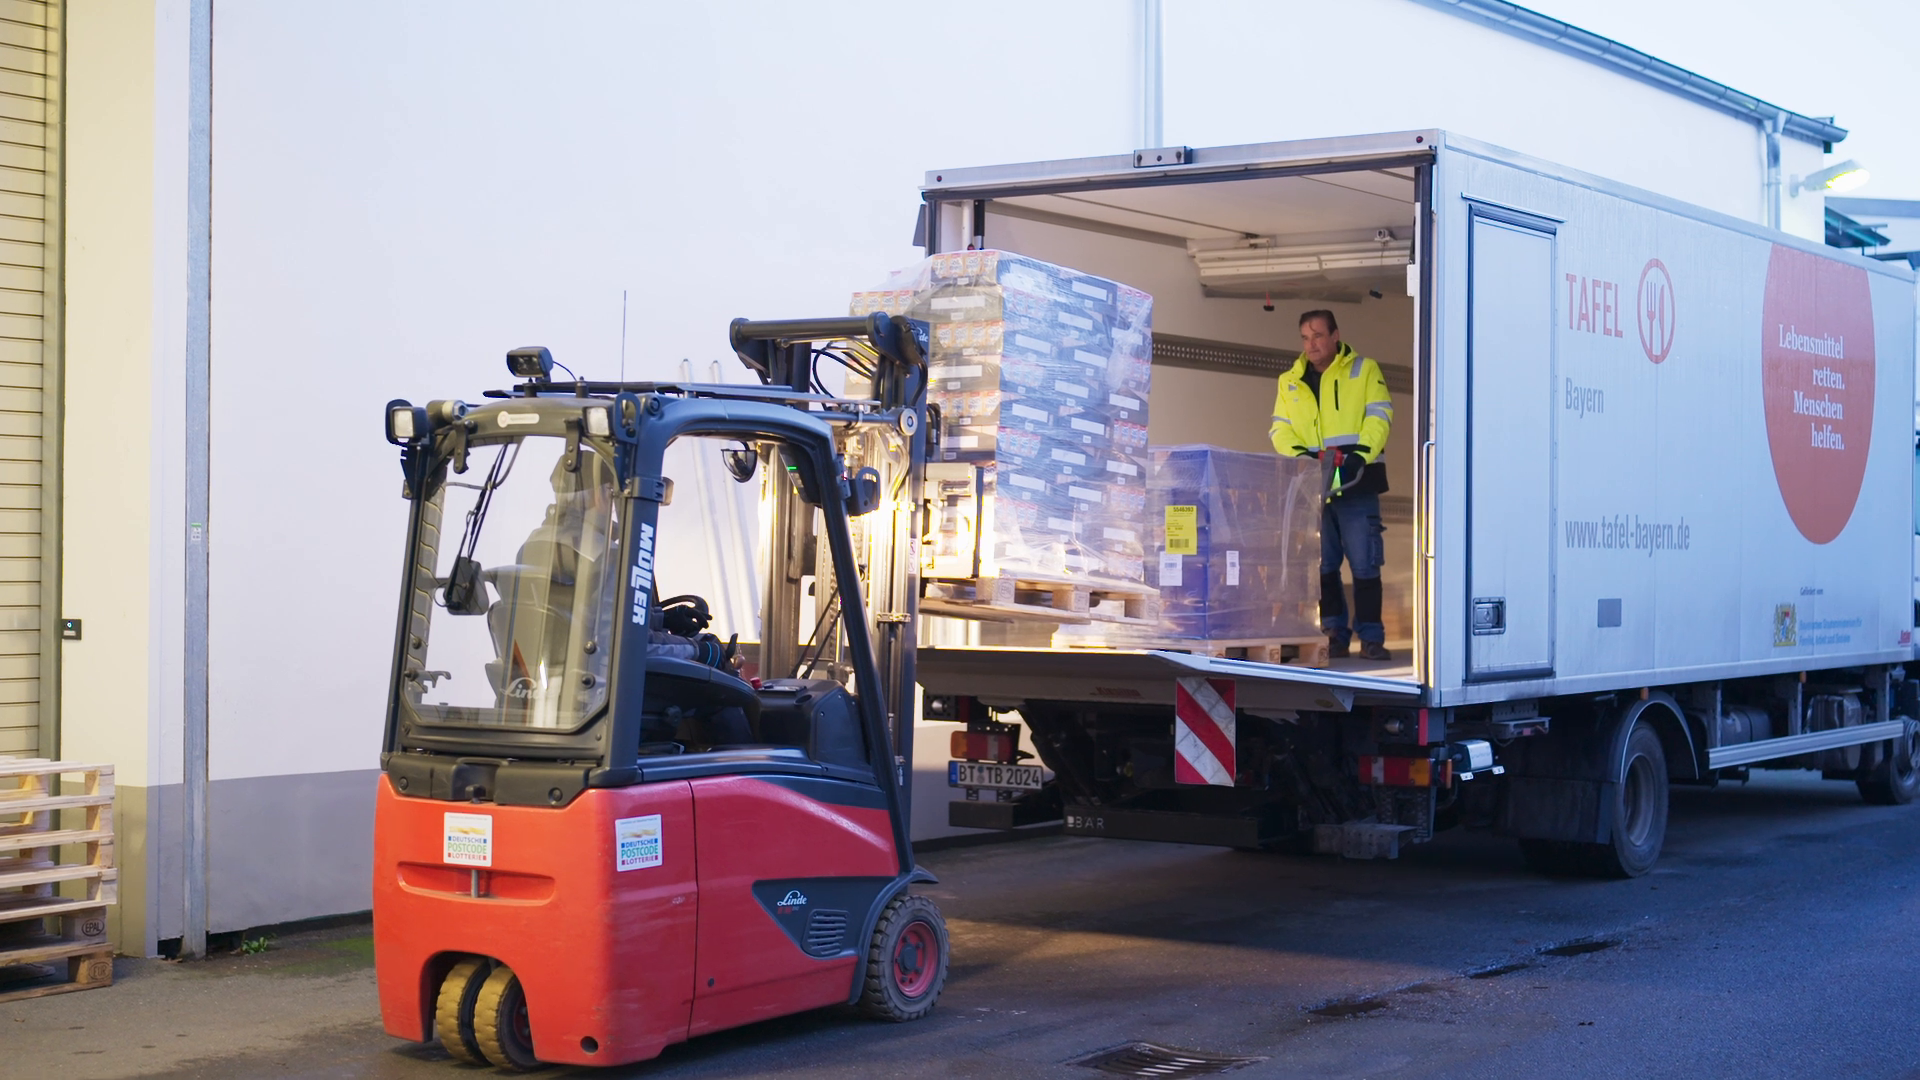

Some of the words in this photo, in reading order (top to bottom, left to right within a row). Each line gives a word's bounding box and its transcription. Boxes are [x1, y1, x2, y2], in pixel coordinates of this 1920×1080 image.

[1566, 273, 1623, 338] TAFEL
[1779, 323, 1844, 359] Lebensmittel
[1812, 366, 1845, 390] retten.
[1566, 377, 1604, 419] Bayern
[1793, 390, 1843, 420] Menschen
[1811, 422, 1845, 450] helfen.
[1565, 514, 1690, 558] www.tafel-bayern.de
[630, 522, 654, 626] MÜLLER
[959, 764, 975, 783] BT
[986, 766, 1003, 784] TB
[1006, 768, 1040, 787] 2024
[448, 842, 487, 855] POSTCODE
[452, 836, 482, 844] DEUTSCHE
[625, 838, 654, 848] DEUTSCHE
[452, 853, 482, 861] LOTTERIE
[621, 845, 659, 859] POSTCODE
[626, 855, 655, 865] LOTTERIE
[777, 890, 808, 906] Linde
[85, 922, 102, 933] EPAL
